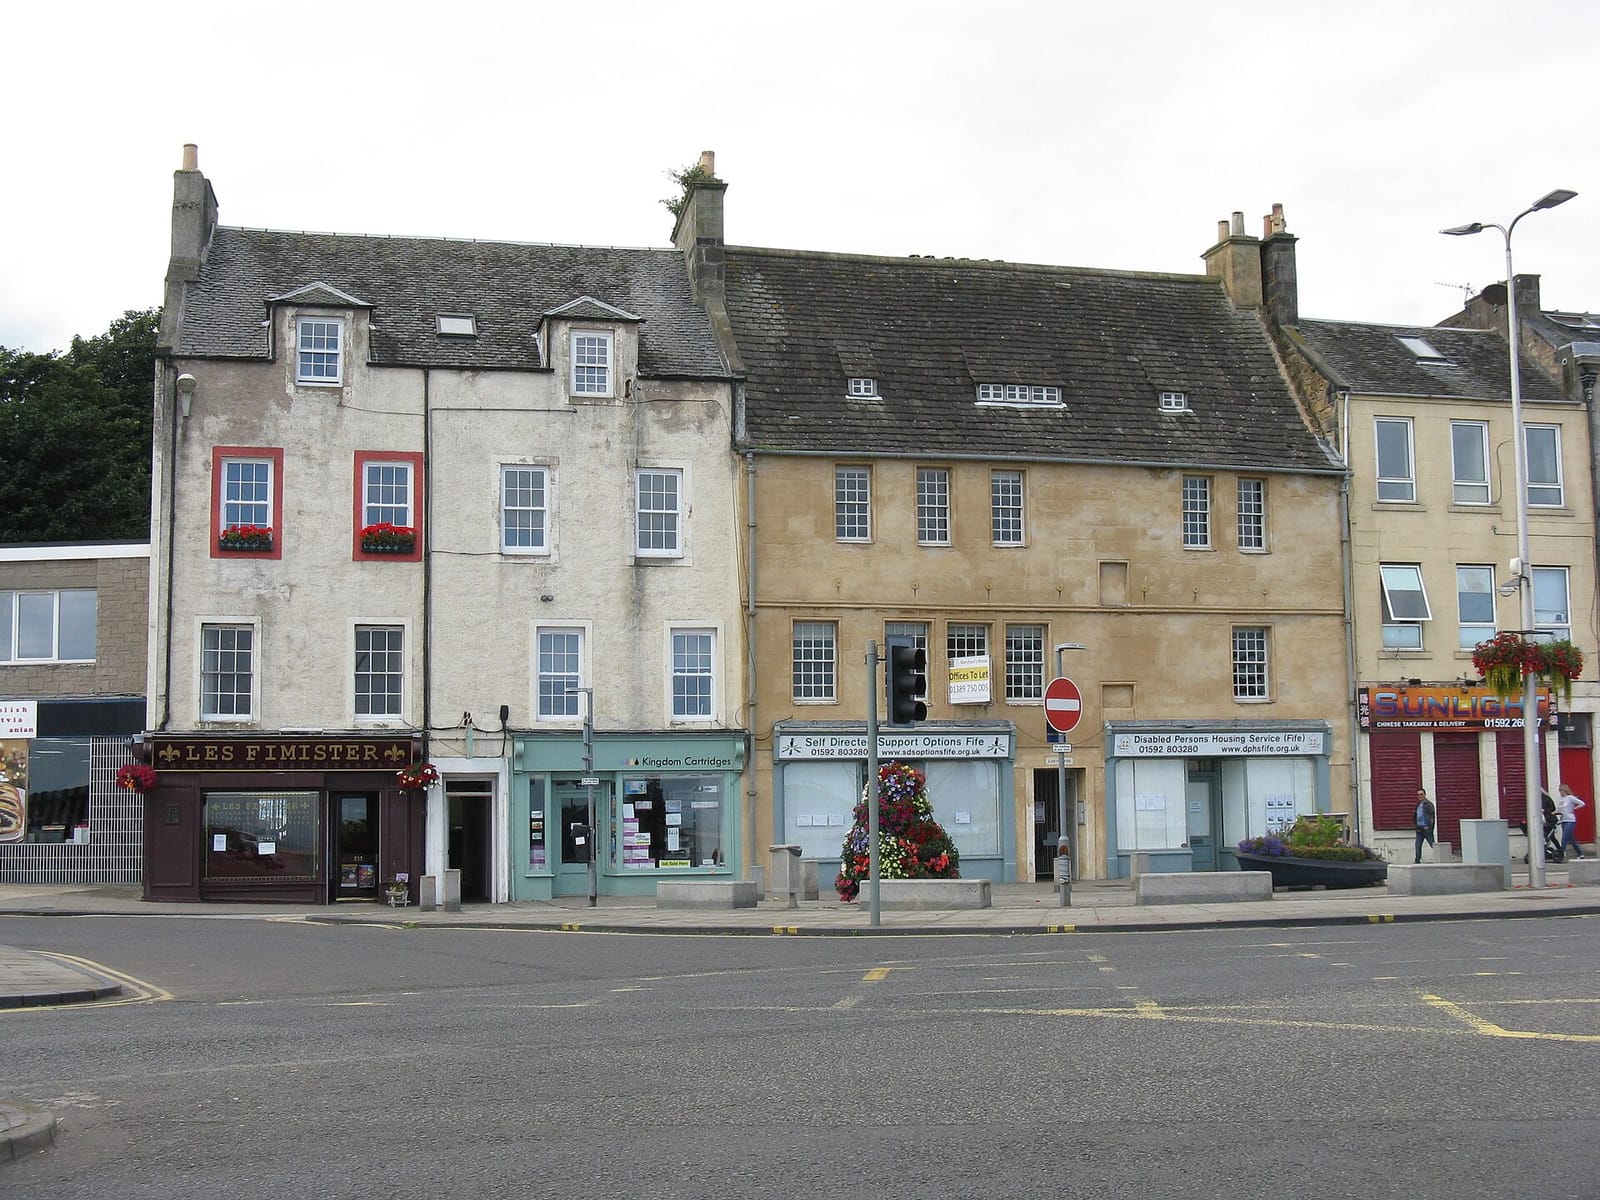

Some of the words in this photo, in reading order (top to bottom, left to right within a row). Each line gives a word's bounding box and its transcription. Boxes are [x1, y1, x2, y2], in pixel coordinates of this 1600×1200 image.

[948, 671, 969, 681] Offices
[970, 671, 978, 679] To
[979, 671, 989, 679] Let
[1484, 718, 1510, 728] 01592
[805, 737, 826, 747] Self
[830, 737, 868, 747] Directe
[878, 737, 919, 748] Support
[923, 736, 962, 747] Options
[966, 737, 985, 746] Fife
[1134, 735, 1172, 744] Disabled
[1174, 735, 1209, 744] Persons
[1212, 735, 1246, 744] Housing
[1249, 734, 1281, 743] Service
[1284, 733, 1306, 743] (Fife)
[186, 745, 234, 761] LES
[246, 744, 379, 761] FIMISTER
[811, 748, 835, 756] 01592
[837, 748, 869, 756] 803280
[881, 748, 980, 757] www.sdsoptionsfife.org.uk
[1138, 745, 1164, 754] 01592
[1166, 745, 1199, 753] 803280
[1221, 744, 1300, 754] www.dphsfife.org.uk
[642, 757, 682, 768] Kingdom
[684, 756, 732, 767] Cartridges
